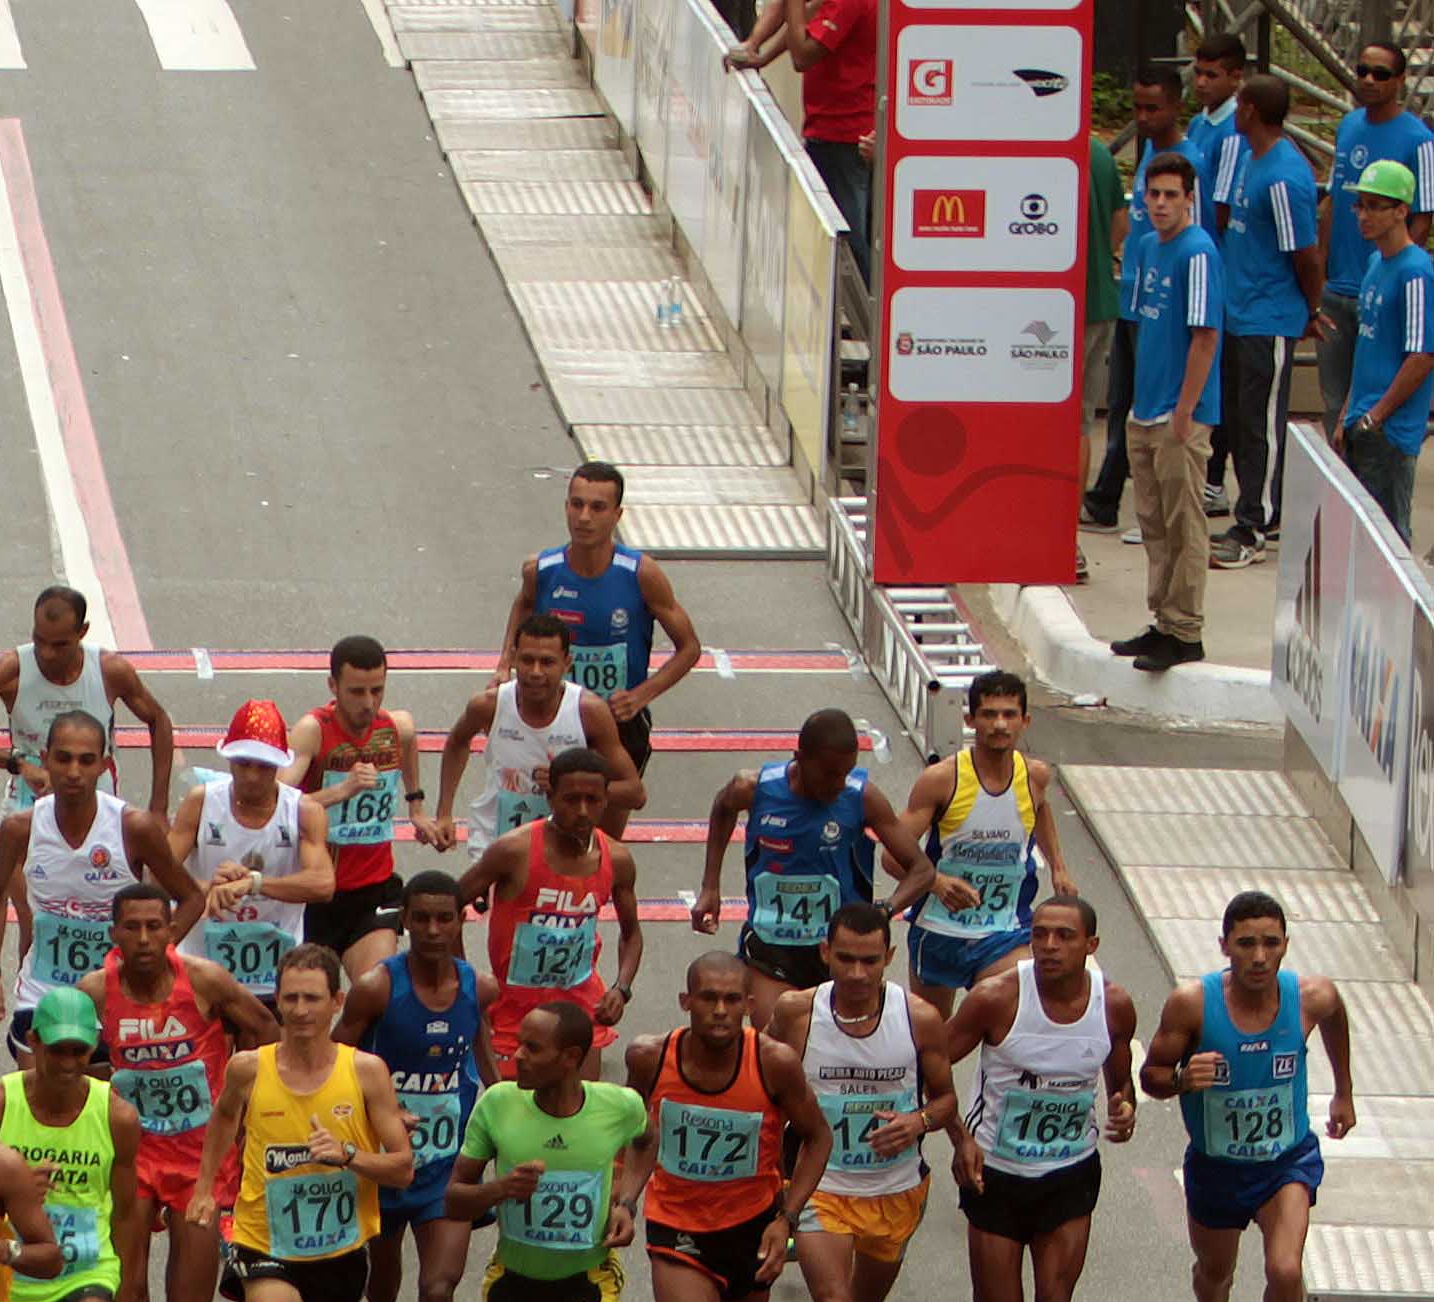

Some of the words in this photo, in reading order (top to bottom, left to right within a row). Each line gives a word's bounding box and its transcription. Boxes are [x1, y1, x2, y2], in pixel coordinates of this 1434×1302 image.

[1008, 222, 1059, 235] GLOBO
[917, 344, 942, 356] SÃO
[945, 345, 987, 356] PAULO
[338, 793, 393, 823] 168
[338, 824, 382, 839] CAIXA
[85, 871, 118, 881] CAIXA
[536, 888, 597, 913] FILA
[769, 895, 832, 926] 141
[774, 926, 829, 939] CAIXA
[216, 939, 280, 974] 301
[119, 1018, 187, 1041] FILA
[123, 1042, 192, 1062] CAIXA
[390, 1070, 460, 1092] CAIXA
[132, 1085, 200, 1117] 130
[1225, 1094, 1279, 1108] CAIXA
[681, 1110, 733, 1131] Rexona
[1013, 1111, 1088, 1144] 165
[1225, 1107, 1284, 1144] 128
[672, 1125, 750, 1163] 172
[1015, 1144, 1071, 1158] CAIXA
[1226, 1141, 1285, 1156] CAIXA
[678, 1160, 734, 1176] CAIXA
[282, 1191, 356, 1234] 170
[515, 1194, 595, 1230] 129
[294, 1230, 348, 1249] CAIXA
[524, 1230, 581, 1243] CAIXA
